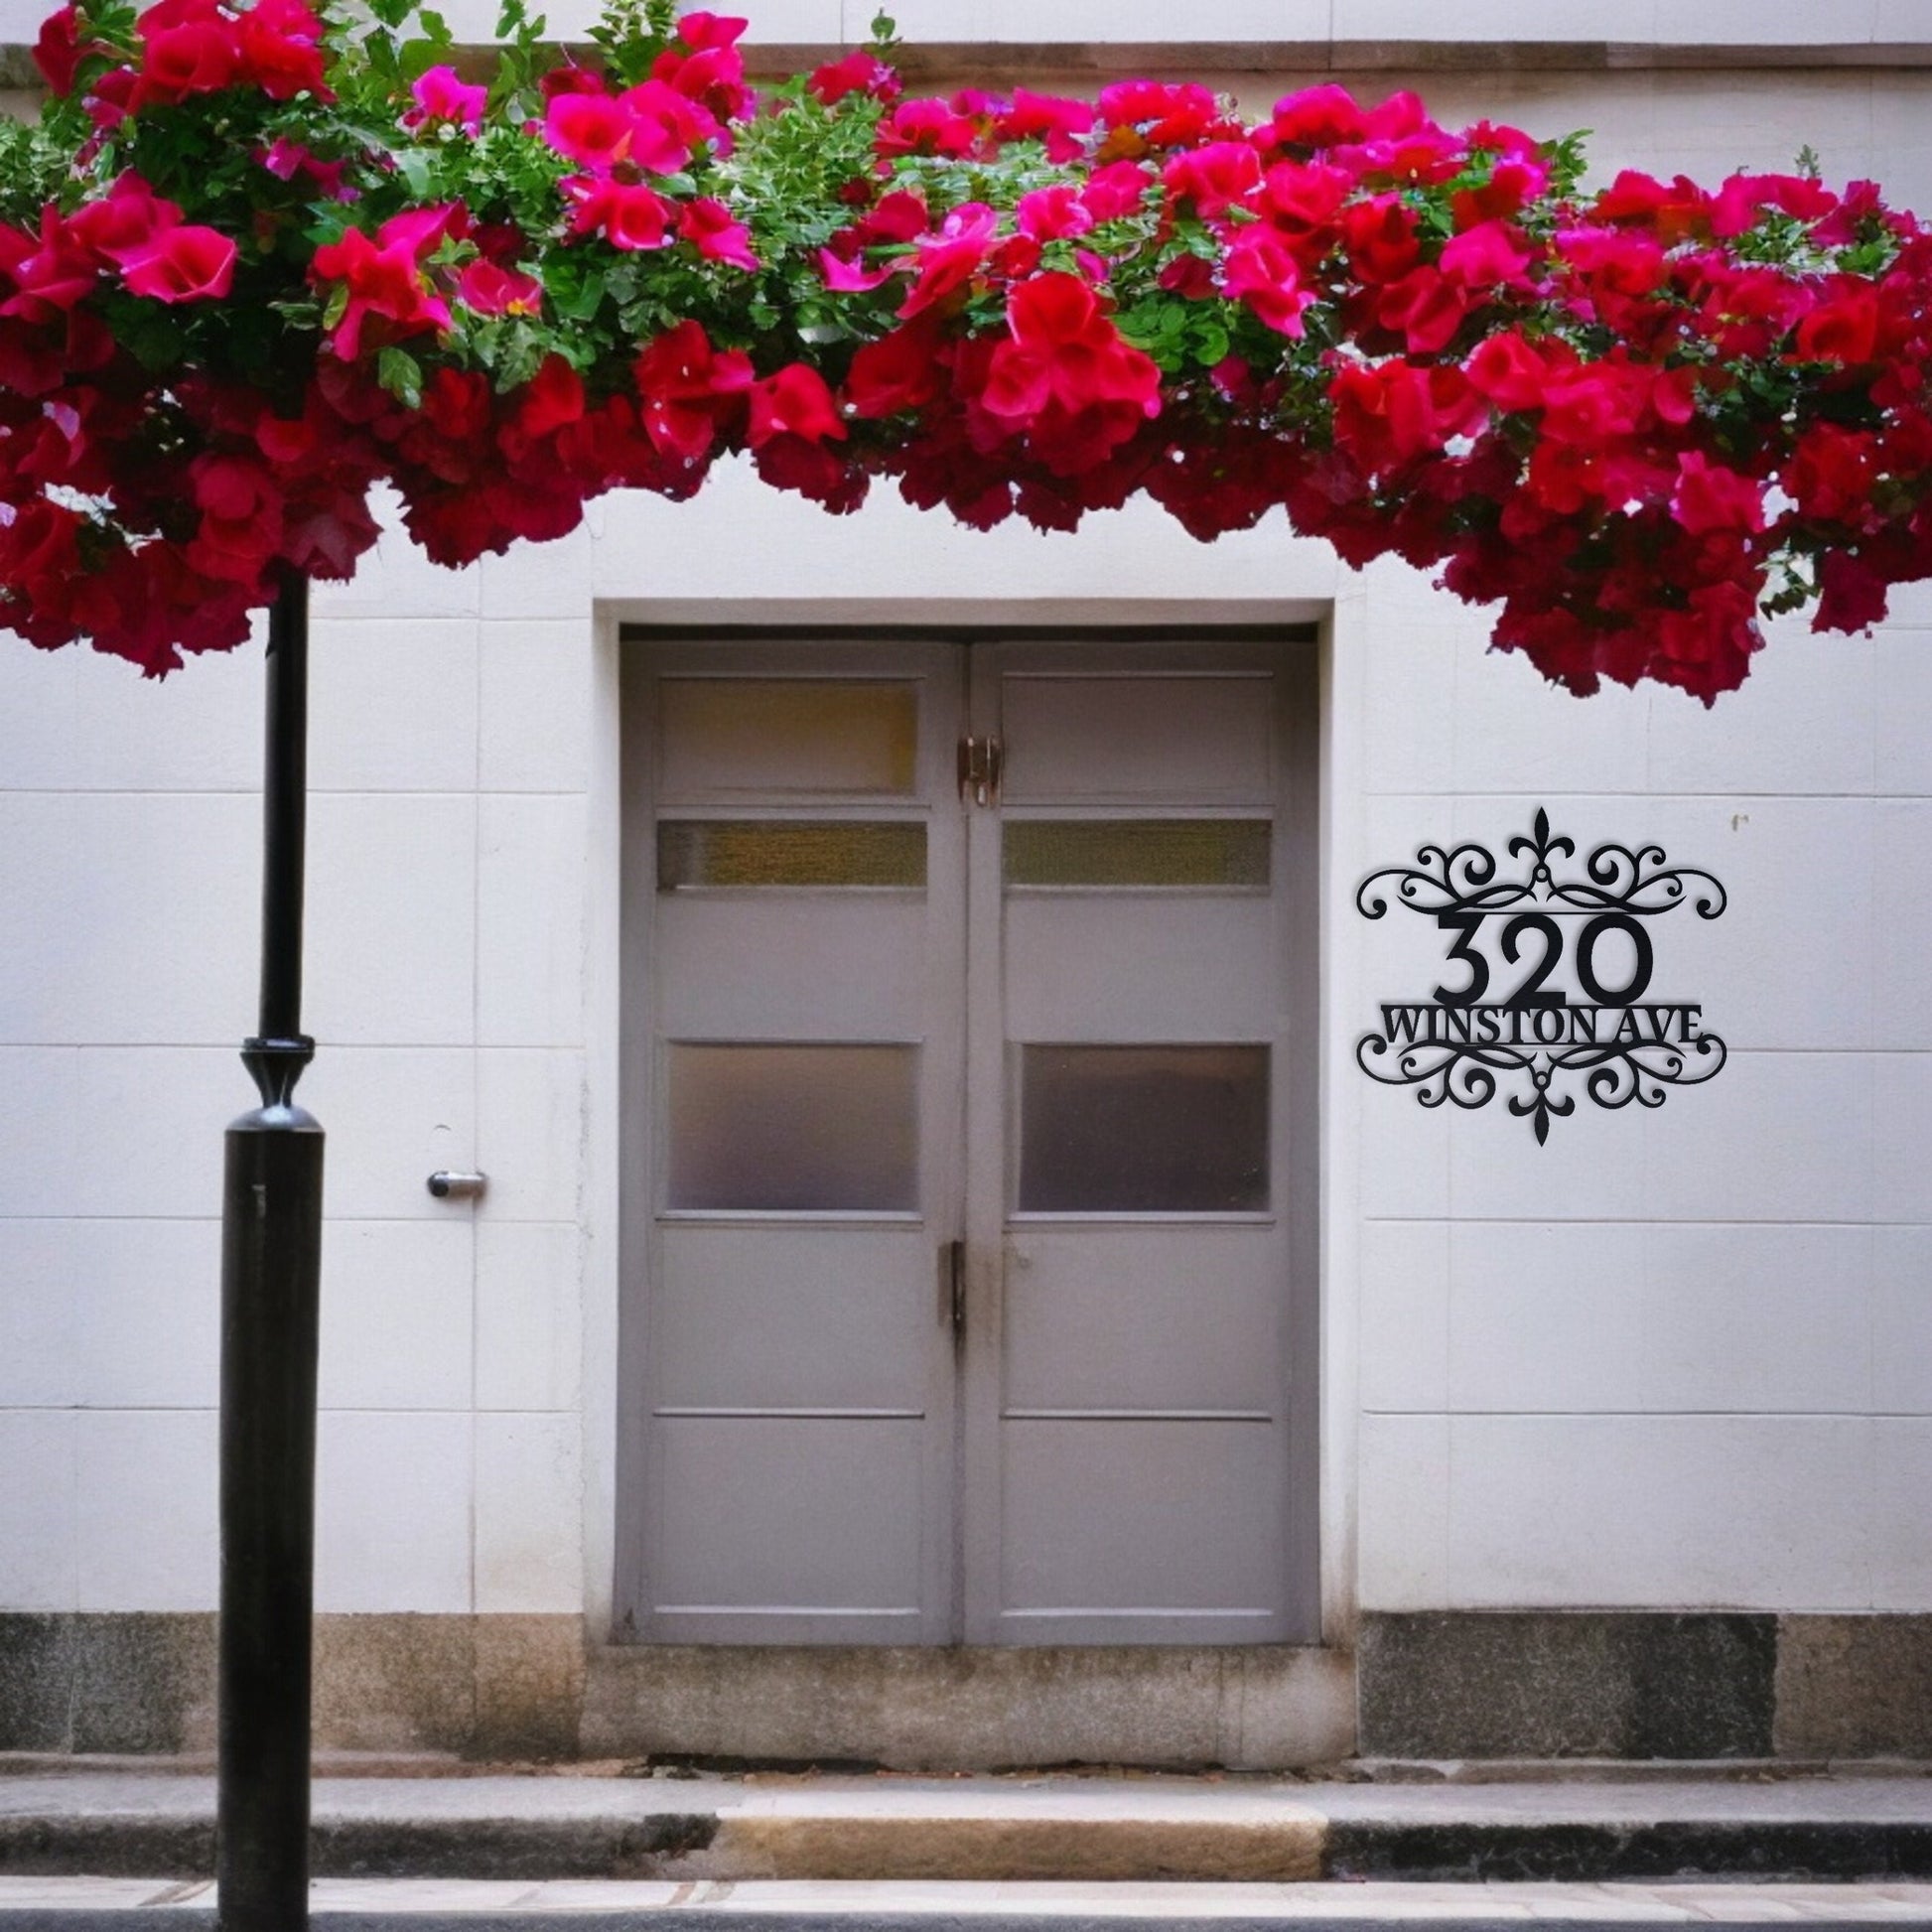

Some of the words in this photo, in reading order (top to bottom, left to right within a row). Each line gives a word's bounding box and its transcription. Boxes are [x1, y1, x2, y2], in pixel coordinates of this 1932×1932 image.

[1433, 913, 1653, 1007] 320
[1381, 1005, 1601, 1043] WINSTON
[1612, 1005, 1703, 1043] AVE
